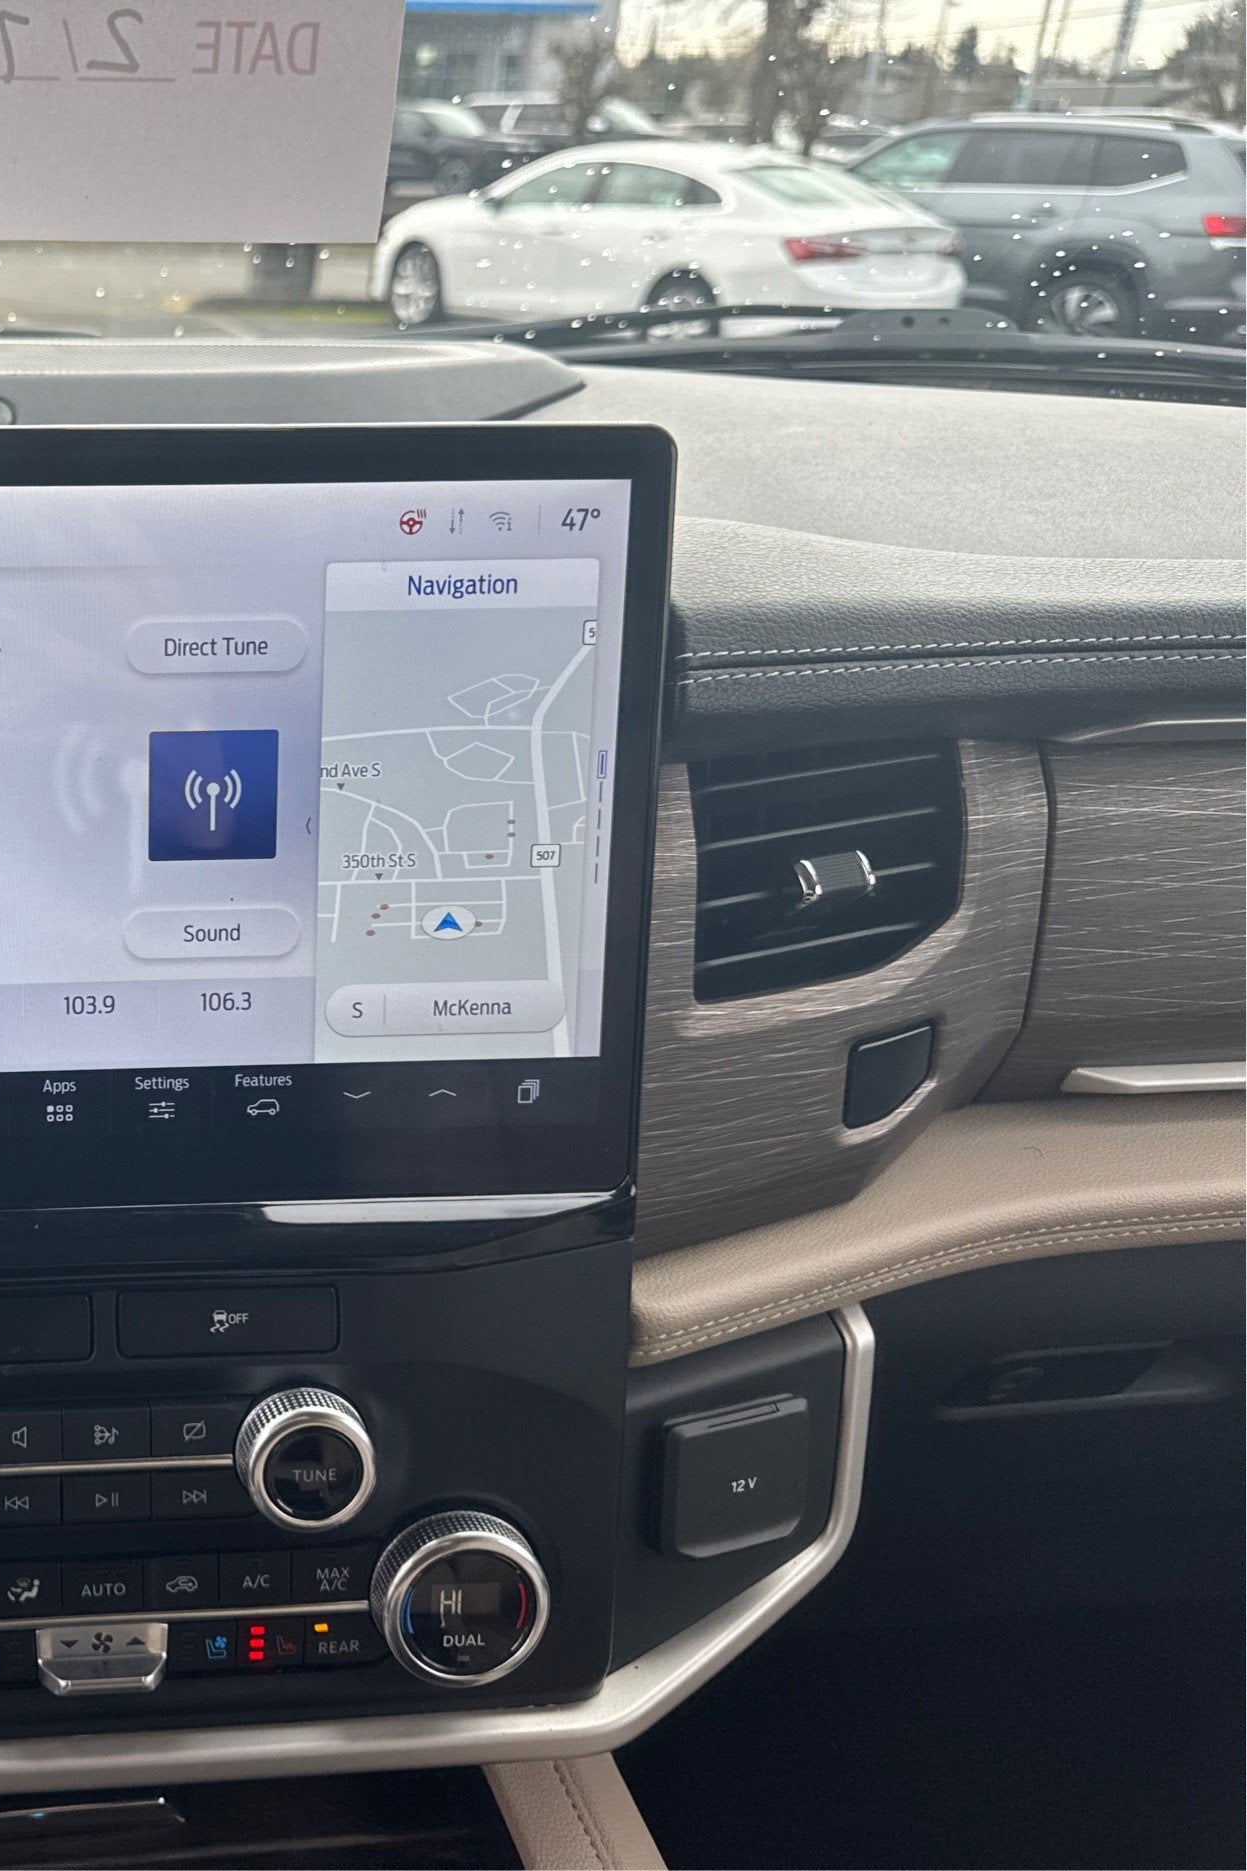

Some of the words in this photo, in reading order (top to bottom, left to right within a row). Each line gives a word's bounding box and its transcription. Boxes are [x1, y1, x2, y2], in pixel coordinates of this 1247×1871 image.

[560, 507, 602, 532] 47°
[407, 573, 518, 600] Navigation
[164, 637, 218, 657] Direct
[221, 636, 269, 656] Tune
[341, 763, 369, 778] Ave
[371, 762, 382, 777] S
[342, 854, 386, 869] 350th
[388, 853, 404, 869] St
[407, 853, 417, 868] S
[535, 850, 556, 861] 507
[182, 922, 241, 943] Sound
[63, 994, 116, 1015] 103.9
[200, 991, 252, 1012] 106.3
[433, 998, 512, 1017] McKenna
[351, 1001, 363, 1019] S
[42, 1078, 77, 1095] Apps
[134, 1076, 190, 1092] Settings
[234, 1073, 294, 1088] Features
[227, 1311, 250, 1326] OFF
[290, 1466, 339, 1485] TUNE
[731, 1479, 745, 1493] 12
[747, 1476, 758, 1490] V
[242, 1574, 270, 1590] A/C
[315, 1566, 351, 1582] MAX
[80, 1582, 127, 1598] AUTO
[318, 1577, 348, 1593] A/C
[439, 1589, 463, 1616] HI
[318, 1639, 360, 1655] REAR
[442, 1633, 486, 1648] DUAL
